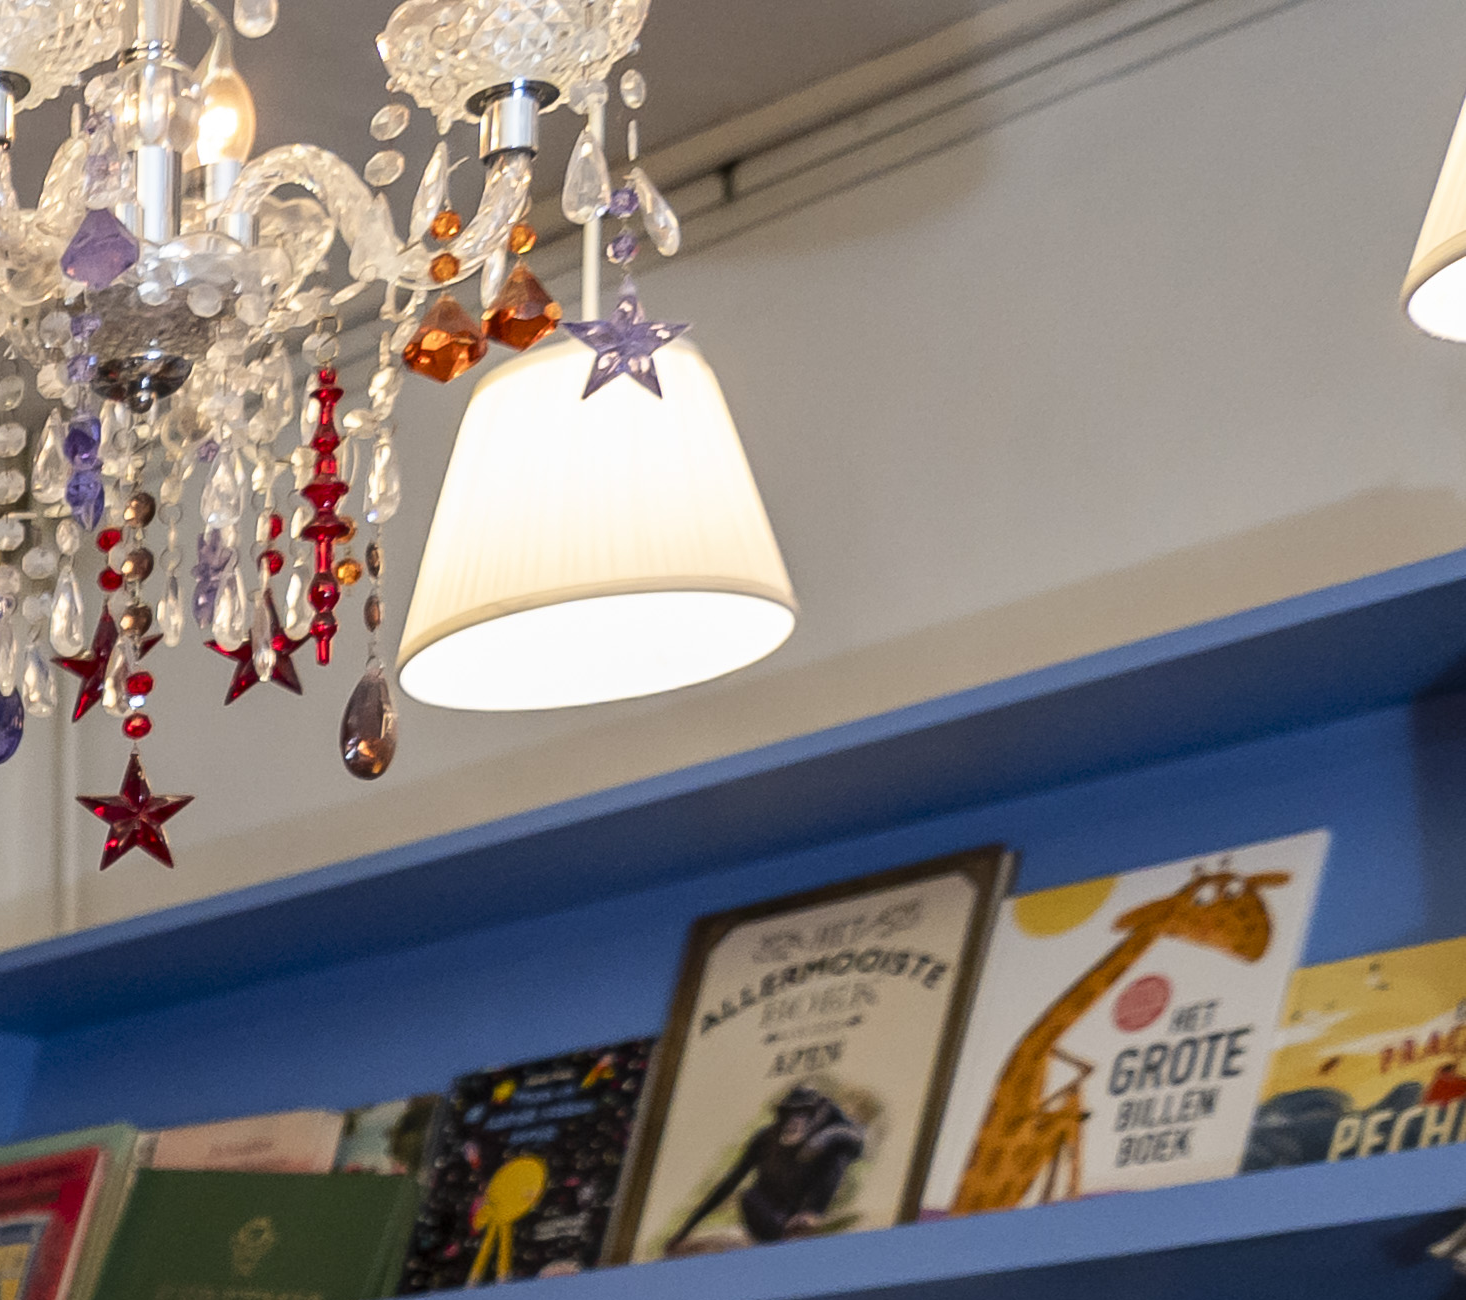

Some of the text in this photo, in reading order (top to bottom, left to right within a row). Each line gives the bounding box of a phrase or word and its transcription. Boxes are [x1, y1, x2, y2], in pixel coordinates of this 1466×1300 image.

[701, 945, 954, 1036] ALLERMOOISTE
[1109, 1025, 1255, 1096] GROTE
[1114, 1088, 1221, 1132] BILLEN
[1115, 1128, 1195, 1169] BOEK
